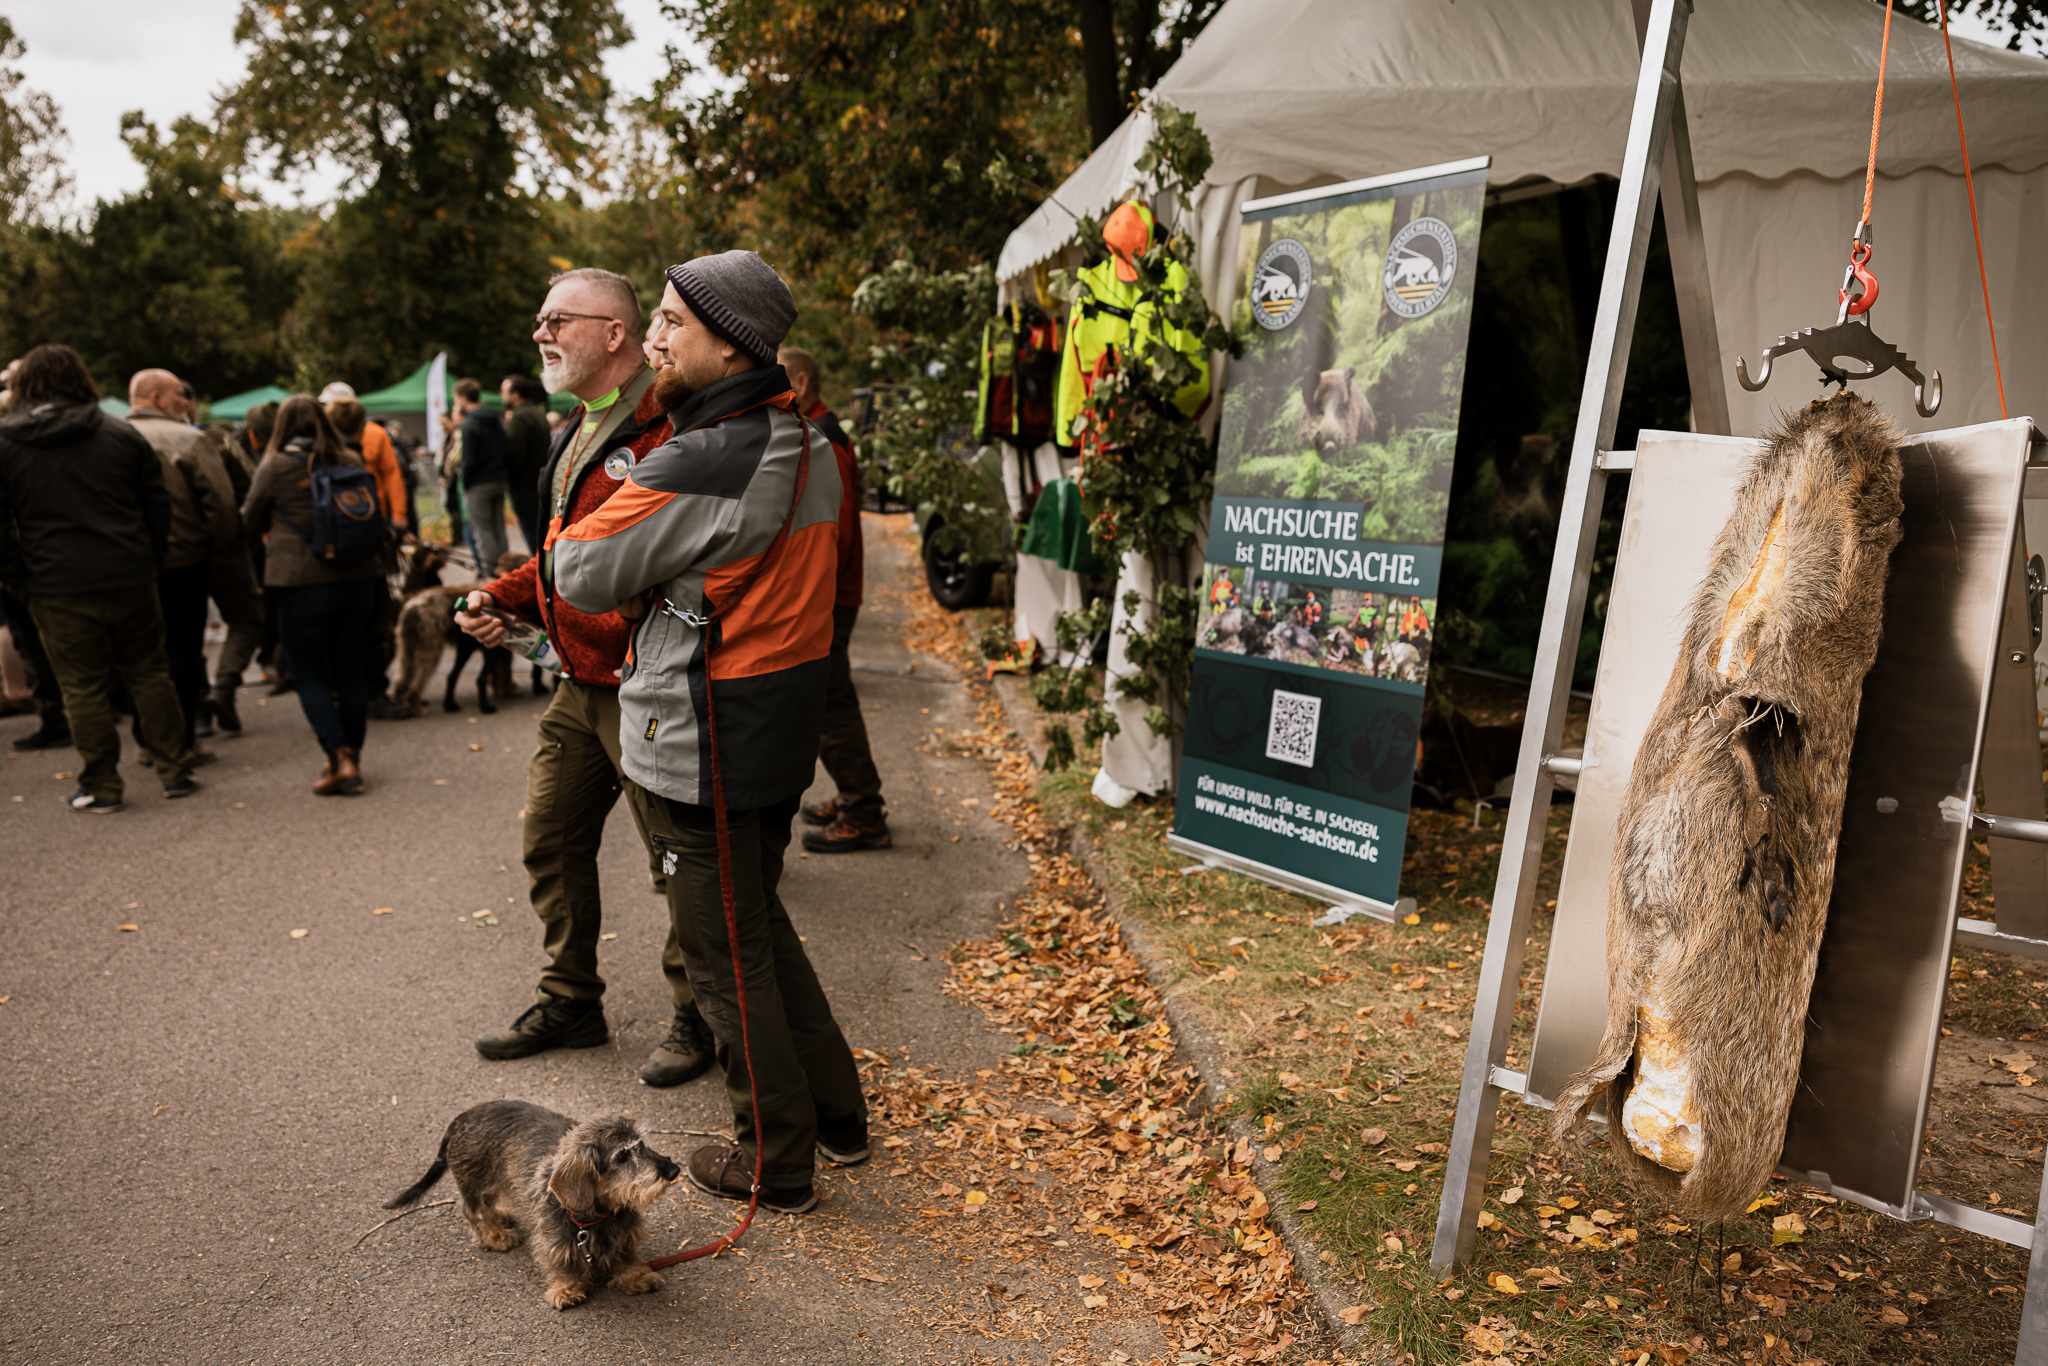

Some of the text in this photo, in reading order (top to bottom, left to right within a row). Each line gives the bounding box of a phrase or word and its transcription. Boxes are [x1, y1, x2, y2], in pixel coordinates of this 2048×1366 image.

[1224, 505, 1359, 541] NACHSUCHE
[1235, 541, 1420, 586] ist EHRENSACHE.
[1195, 795, 1379, 863] www.nachsuche-sachsen.de
[1197, 775, 1380, 841] FÜR UNSER WILD. FÜR SIE. IN SACHSEN.
